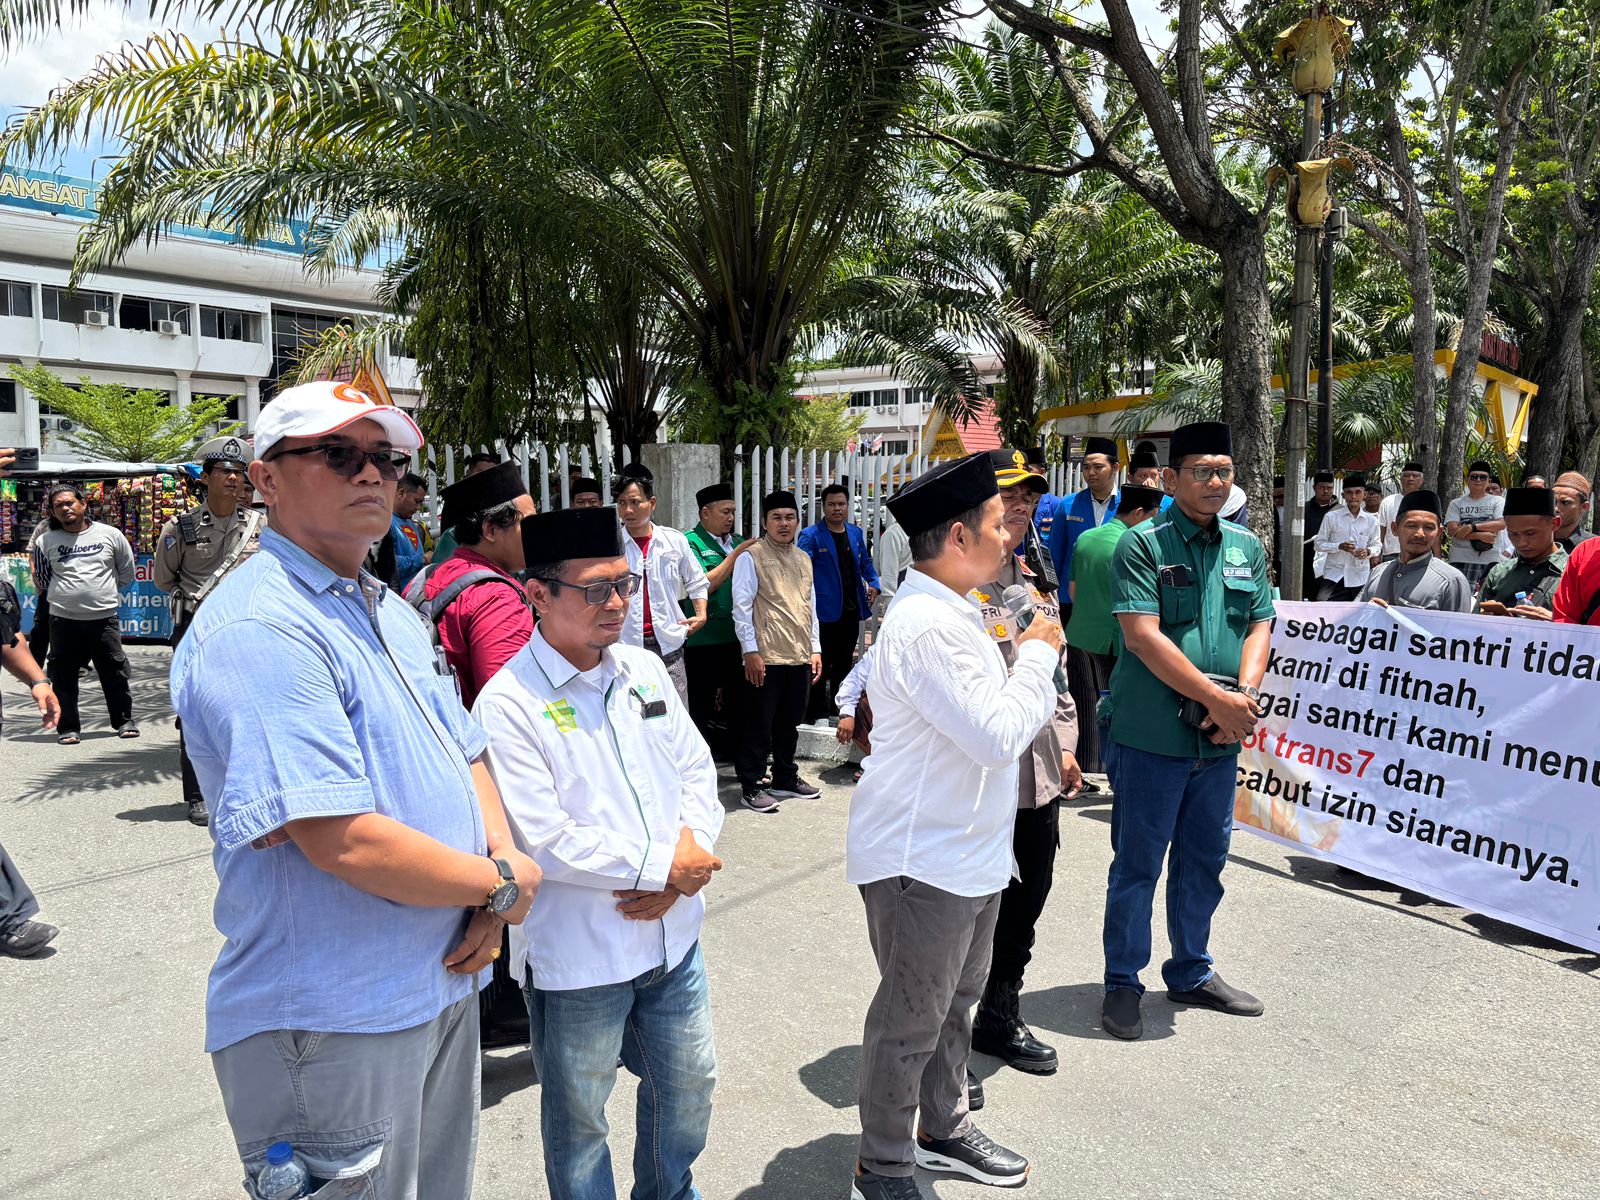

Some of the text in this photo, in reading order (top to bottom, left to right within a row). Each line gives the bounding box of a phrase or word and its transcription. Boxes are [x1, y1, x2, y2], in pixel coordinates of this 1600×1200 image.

[118, 591, 170, 608] Miner
[119, 615, 159, 634] ungi
[1266, 647, 1485, 719] kami di fitnah,
[1284, 617, 1399, 655] sebagai
[1408, 634, 1512, 669] santri
[1523, 641, 1600, 682] tida
[1253, 692, 1301, 720] gai
[1306, 703, 1398, 741] santri
[1407, 715, 1493, 762] kami
[1241, 727, 1445, 799] ot trans7 dan
[1236, 767, 1313, 808] cabut
[1321, 785, 1377, 826] izin
[1386, 808, 1579, 888] siarannya.
